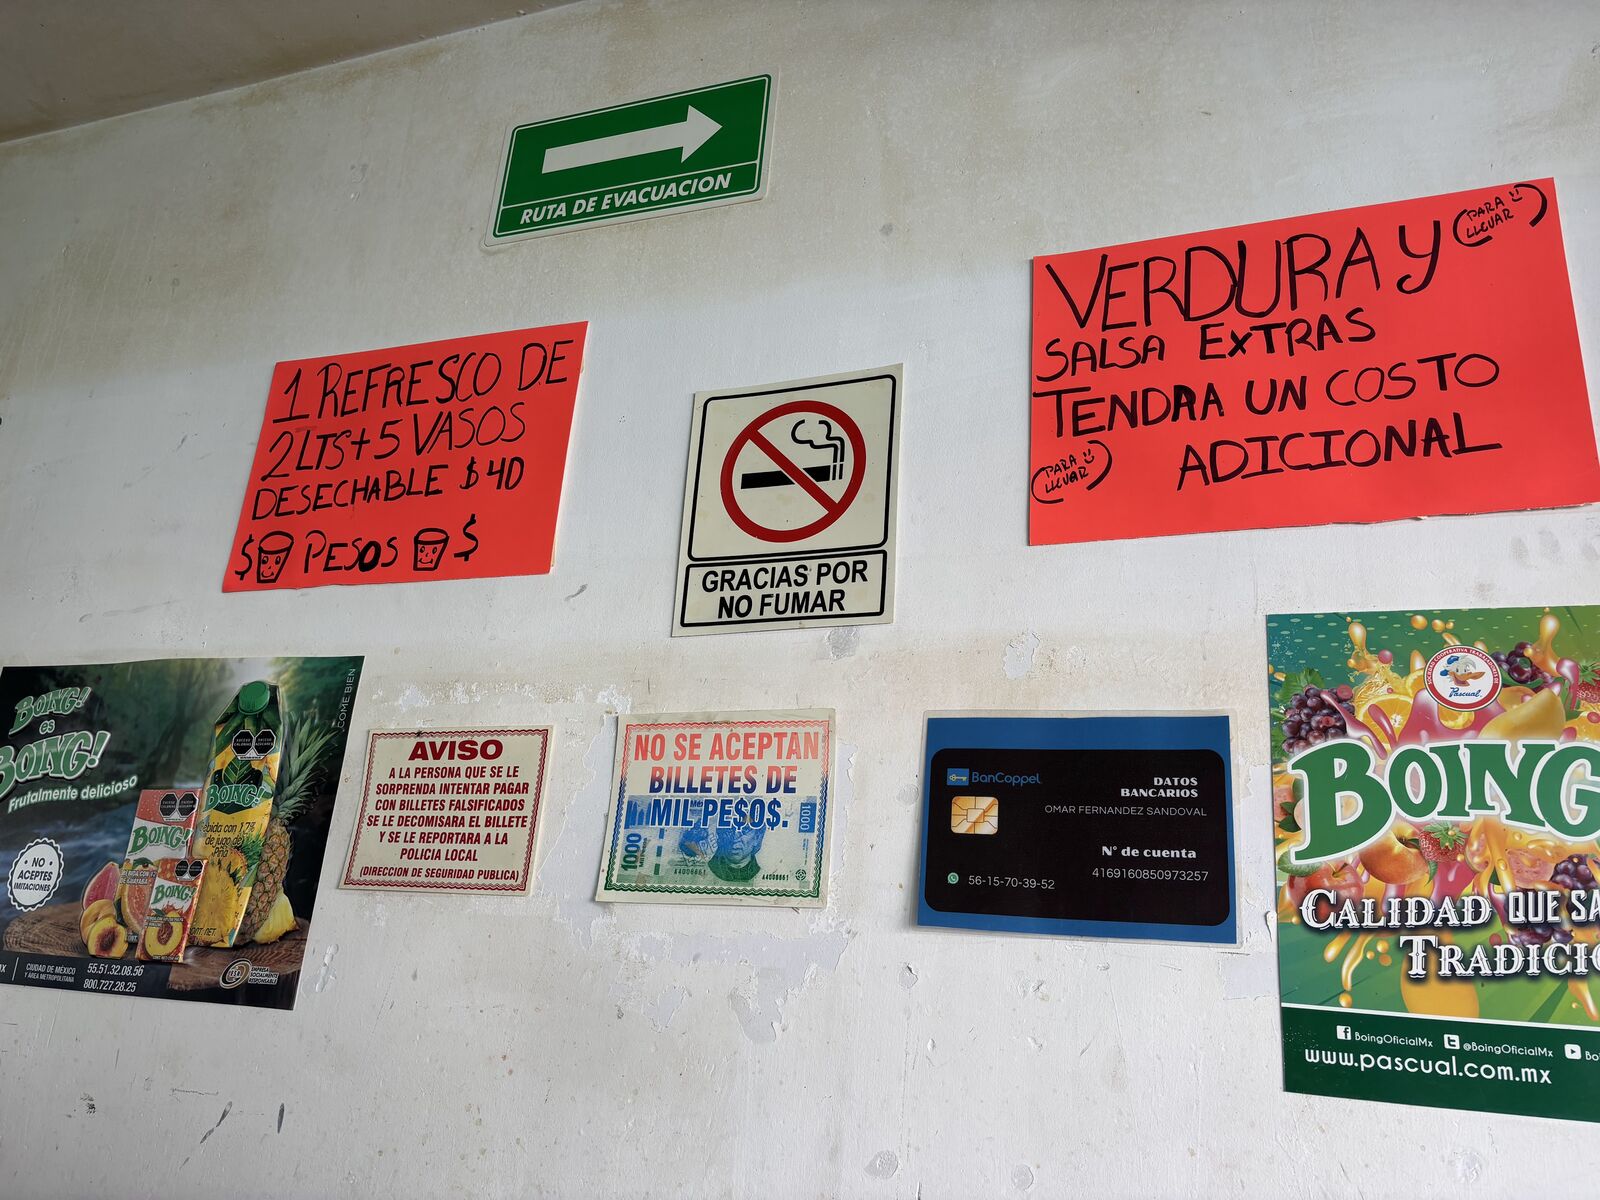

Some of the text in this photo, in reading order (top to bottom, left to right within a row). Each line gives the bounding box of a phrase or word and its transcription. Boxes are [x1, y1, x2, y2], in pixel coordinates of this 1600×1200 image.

[520, 172, 732, 225] RUTA DE EVACUACION
[1045, 227, 1381, 332] VERDURA
[1036, 307, 1376, 382] SALSA EXTRAS
[273, 339, 574, 424] 1 REFRESCO DE
[1245, 376, 1307, 415] UN
[1325, 353, 1500, 406] COSTO
[413, 402, 526, 456] VASOS
[1176, 412, 1502, 491] ADICIONAL
[251, 464, 449, 520] DESECHABLE
[304, 529, 398, 574] PESOS
[702, 560, 868, 592] GRACIAS POR
[717, 589, 846, 619] NO FUMAR
[337, 668, 356, 728] COME BIEN
[1449, 688, 1482, 698] Pascual
[8, 686, 92, 736] BOING!
[39, 720, 55, 734] es
[408, 739, 503, 761] AVISO
[634, 731, 819, 761] NO SE ACEPTAN
[389, 766, 519, 778] A LA PERSONA QUE SE LE
[649, 766, 798, 794] BILLETES DE
[972, 772, 1041, 787] BanCoppel
[376, 782, 529, 795] SORPRENDA INTENTAR PAGAR
[1154, 776, 1198, 786] DATOS
[8, 775, 138, 814] Frutalmente delicioso
[203, 783, 266, 813] BOING!
[1121, 788, 1198, 798] BANCARIOS
[376, 799, 525, 811] CON BILLETES FALSIFICADOS
[650, 798, 695, 828] MIL
[1045, 805, 1207, 816] OMAR FERNANDEZ SANDOVAL
[367, 815, 528, 828] SE LE DECOMISARA EL BILLETE
[801, 805, 811, 830] 1000
[128, 825, 194, 854] BOING!
[379, 832, 508, 844] Y SE LE REPORTARA A LA
[400, 848, 478, 861] POLICIA LOCAL
[621, 833, 642, 871] 1000
[1122, 847, 1139, 857] de
[1143, 848, 1196, 859] cuenta
[32, 857, 45, 867] NO
[17, 870, 53, 881] ACEPTES
[360, 866, 519, 882] (DIRECCION DE SEGURIDAD PUBLICA)
[968, 875, 1055, 890] 56-15-70-39-52
[1092, 867, 1209, 882] 4169160850973257
[14, 883, 51, 892] IMITACIONES
[151, 884, 197, 904] BOING!
[1508, 889, 1562, 924] QUE
[26, 963, 76, 975] CIUDAD DE MÉXICO
[87, 963, 145, 976] 55.51.32.08.56
[40, 974, 75, 982] METROPOLITANA
[84, 978, 137, 992] 800.727.28.25
[1355, 1031, 1433, 1048] BoingOficialMx
[1463, 1042, 1554, 1058] @BoingOficialMx
[1585, 1051, 1600, 1061] Bo
[1304, 1048, 1552, 1085] www.pascual.com.mx
